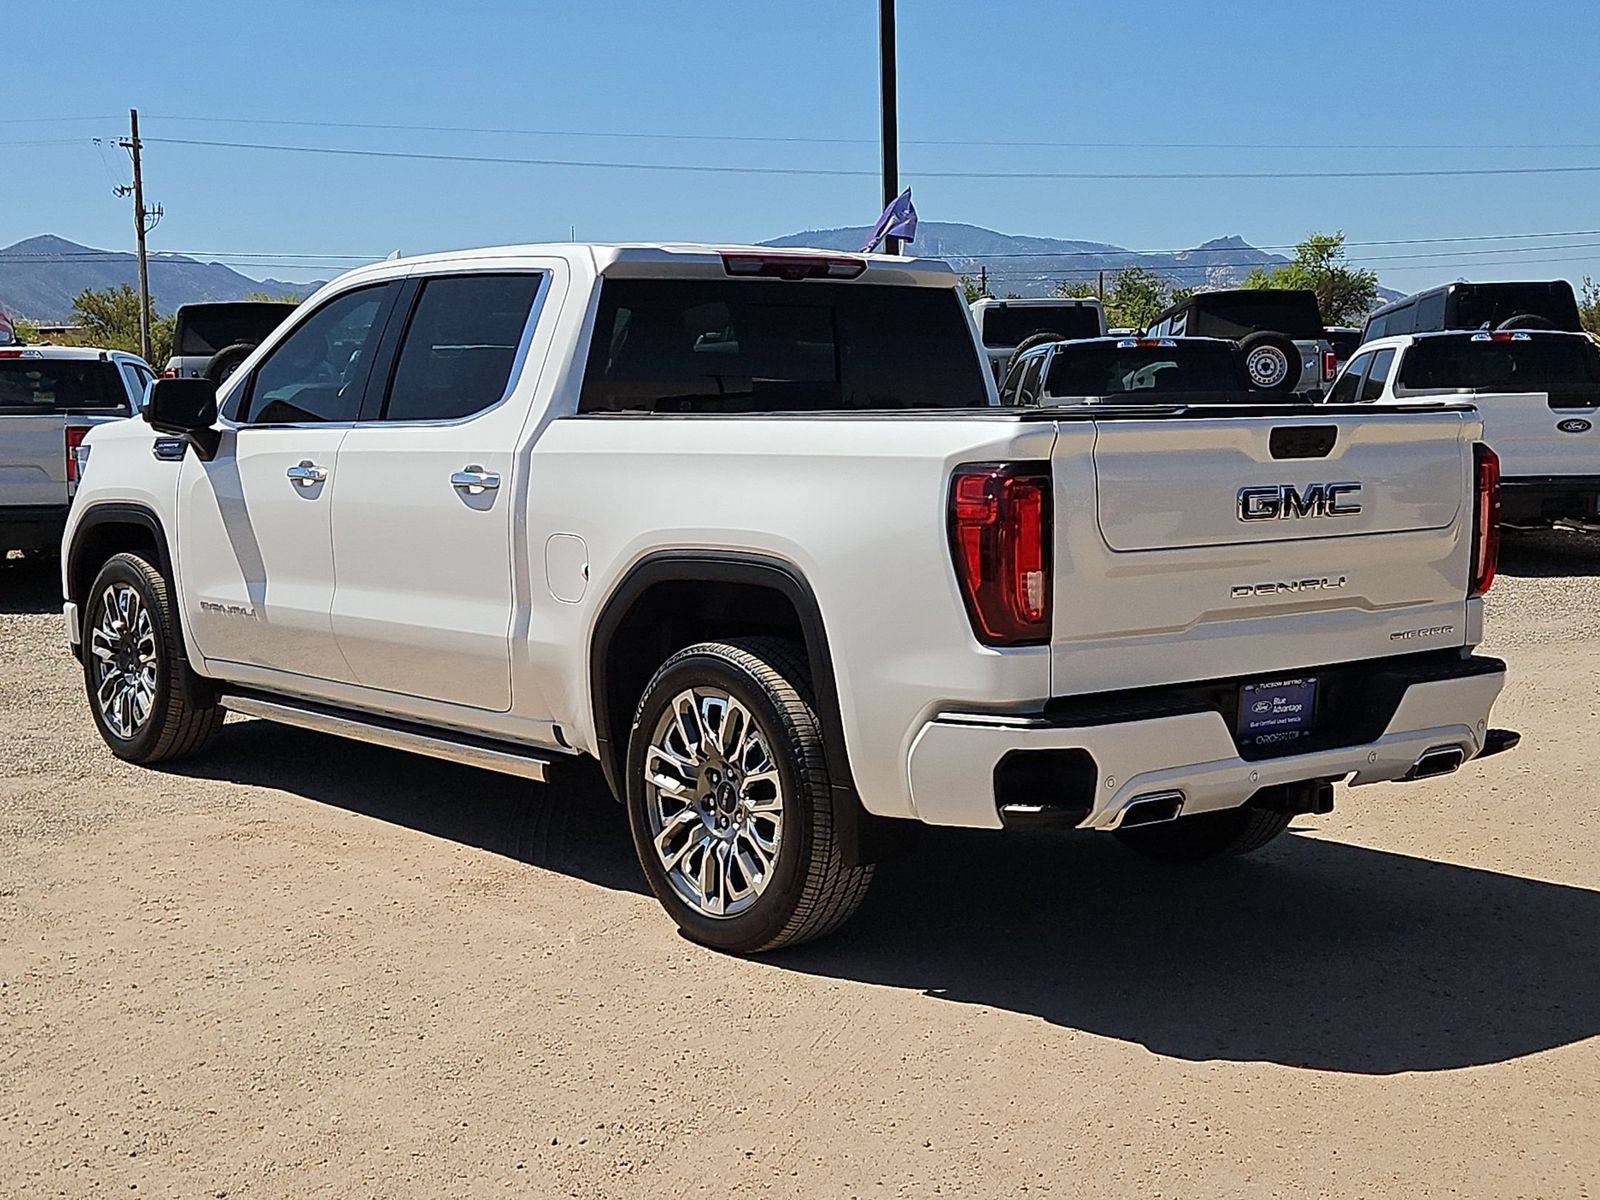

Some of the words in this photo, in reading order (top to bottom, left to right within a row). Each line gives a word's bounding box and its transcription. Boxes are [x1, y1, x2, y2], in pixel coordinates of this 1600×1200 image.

[1236, 482, 1362, 522] GMC
[1230, 576, 1347, 599] DENALI
[1390, 625, 1455, 641] SIERRA
[1272, 704, 1302, 713] Advantage
